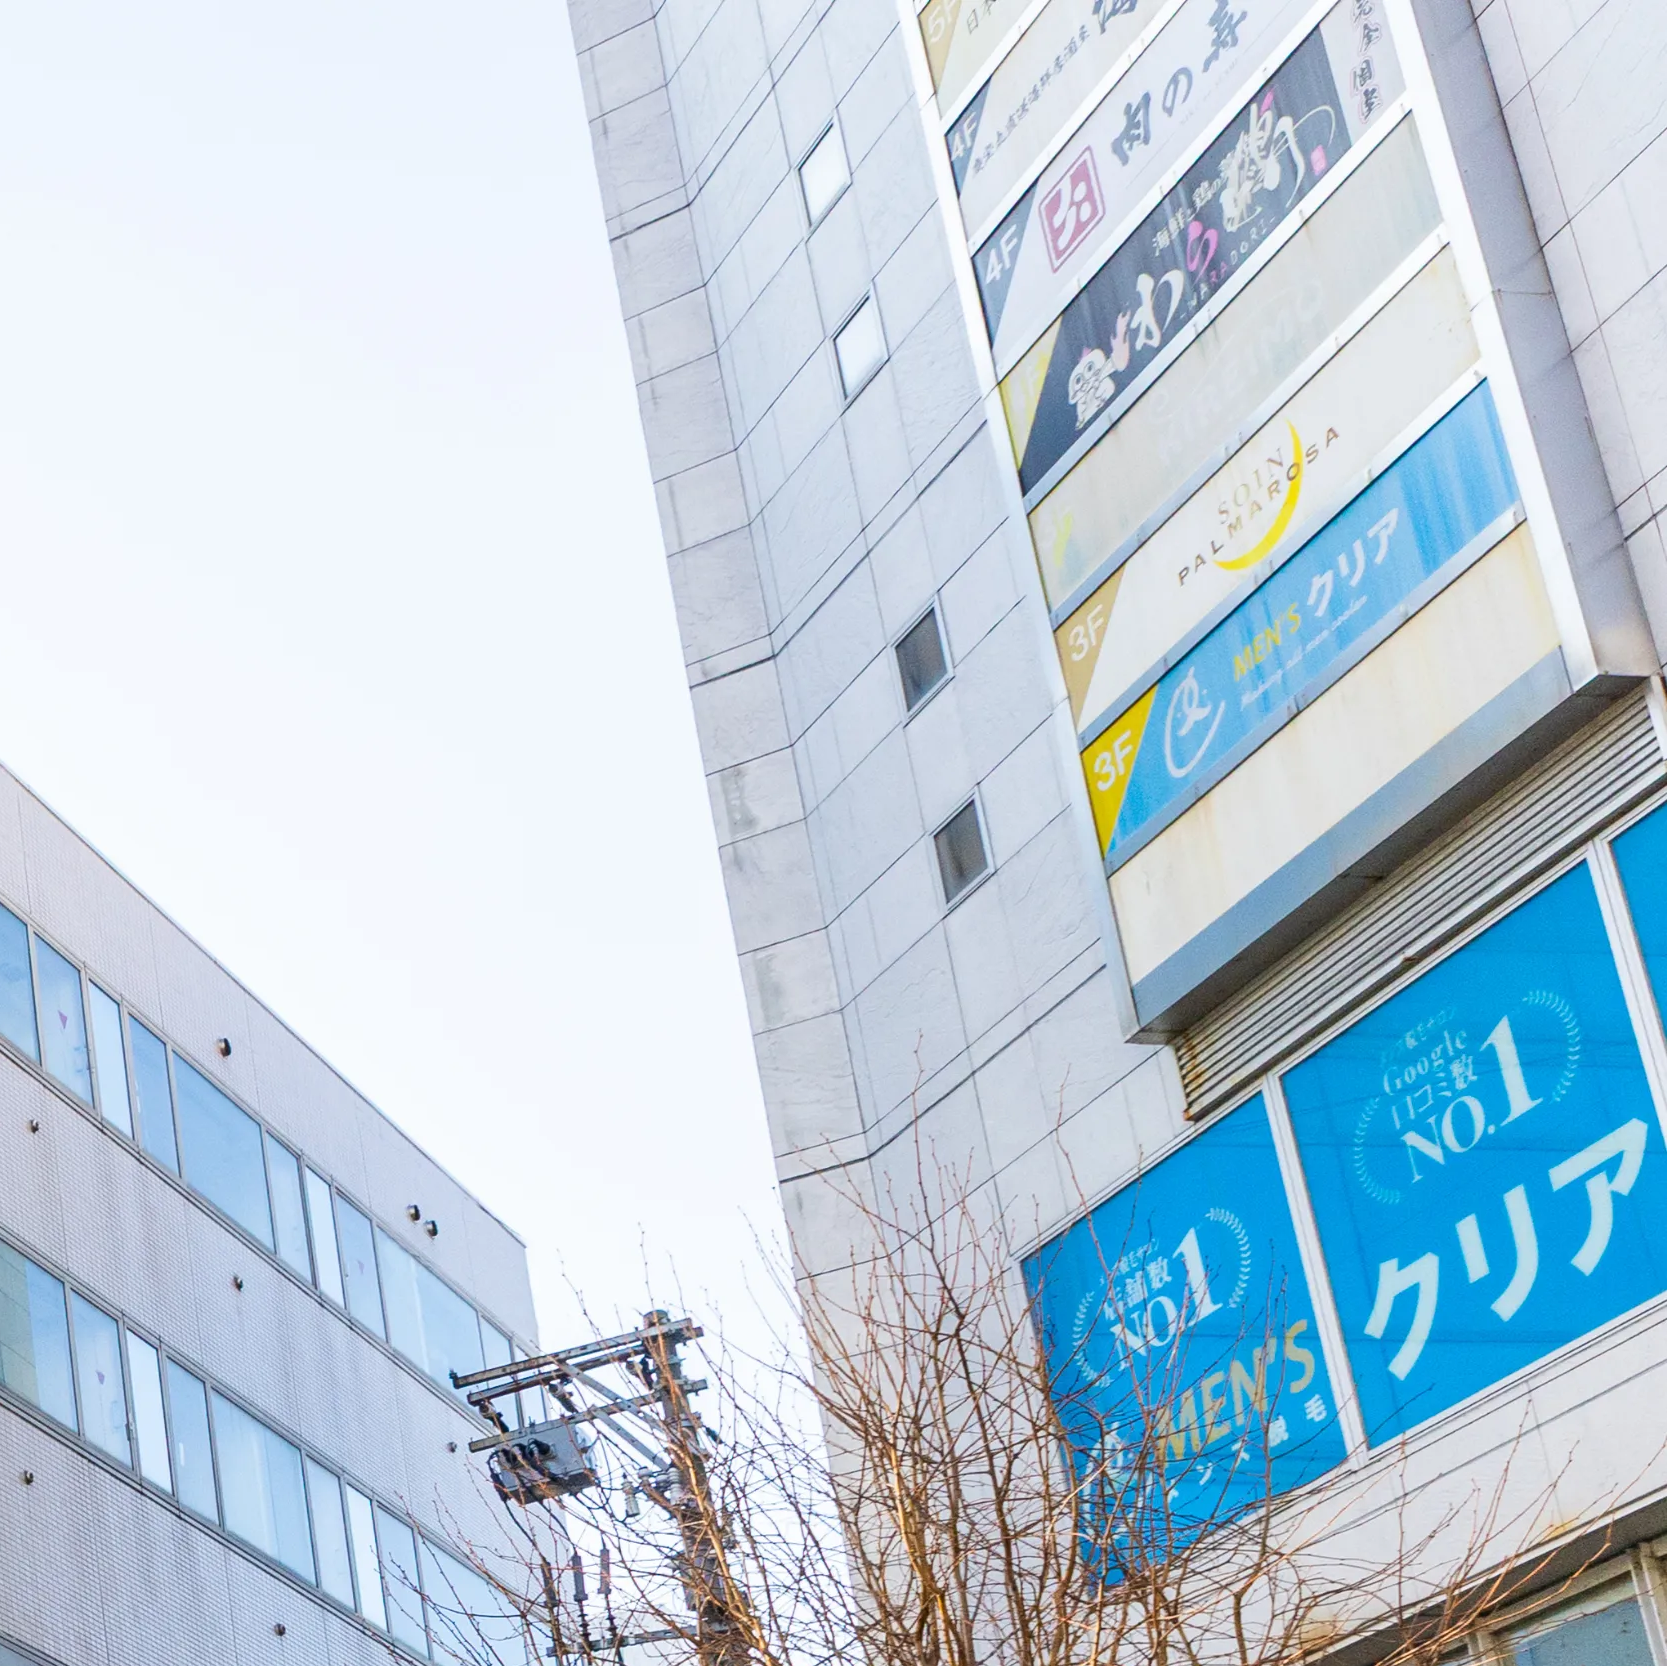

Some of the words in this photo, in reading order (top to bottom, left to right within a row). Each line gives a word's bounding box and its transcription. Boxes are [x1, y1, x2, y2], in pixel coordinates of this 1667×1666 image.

[951, 111, 978, 160] 4F
[985, 221, 1018, 284] 4F
[1176, 426, 1341, 587] PALMAROSA
[1216, 446, 1286, 527] SOIN
[1067, 604, 1105, 663] 3F
[1234, 602, 1302, 681] MEN'S
[1307, 508, 1399, 617] クリア
[1093, 730, 1135, 791] 3F
[1383, 1030, 1467, 1096] Google
[1391, 1054, 1478, 1130] 口コミ数
[1400, 1014, 1544, 1184] NO.1
[1363, 1117, 1649, 1382] クリア
[1157, 1318, 1316, 1462] MEN'S
